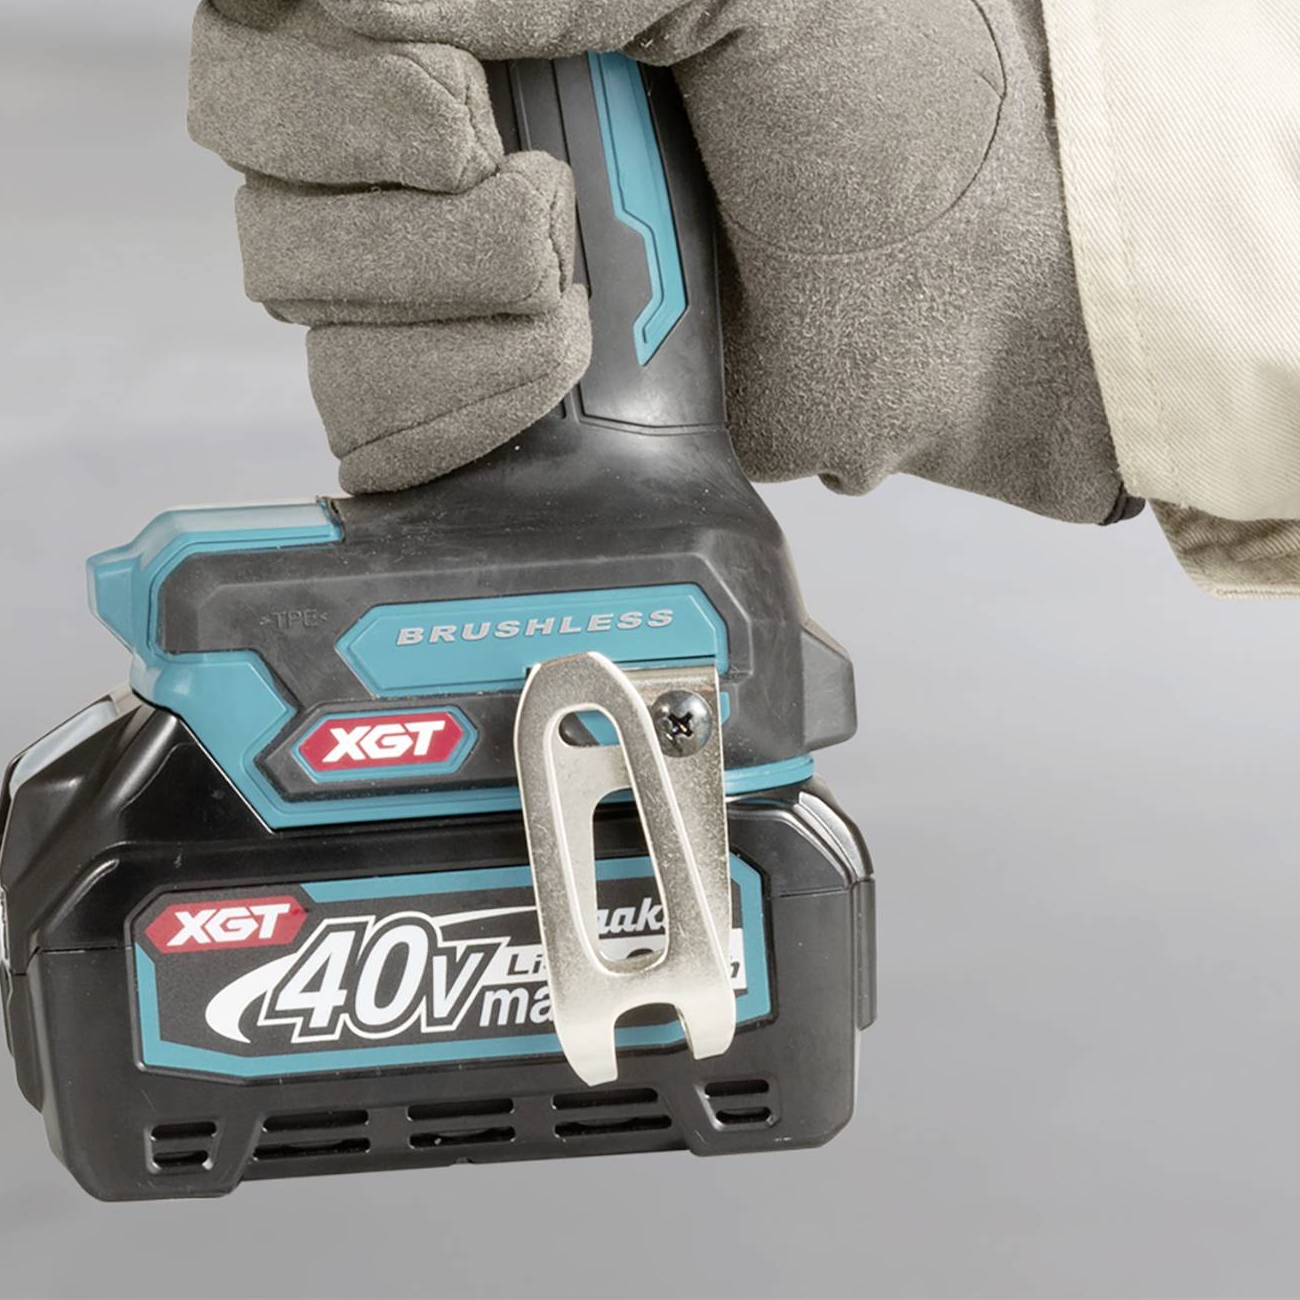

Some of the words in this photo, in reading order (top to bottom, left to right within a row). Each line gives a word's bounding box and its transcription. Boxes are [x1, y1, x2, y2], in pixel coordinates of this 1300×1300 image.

[396, 609, 674, 646] BRUSHLESS
[321, 720, 446, 763] XGT
[166, 903, 291, 947] XGT
